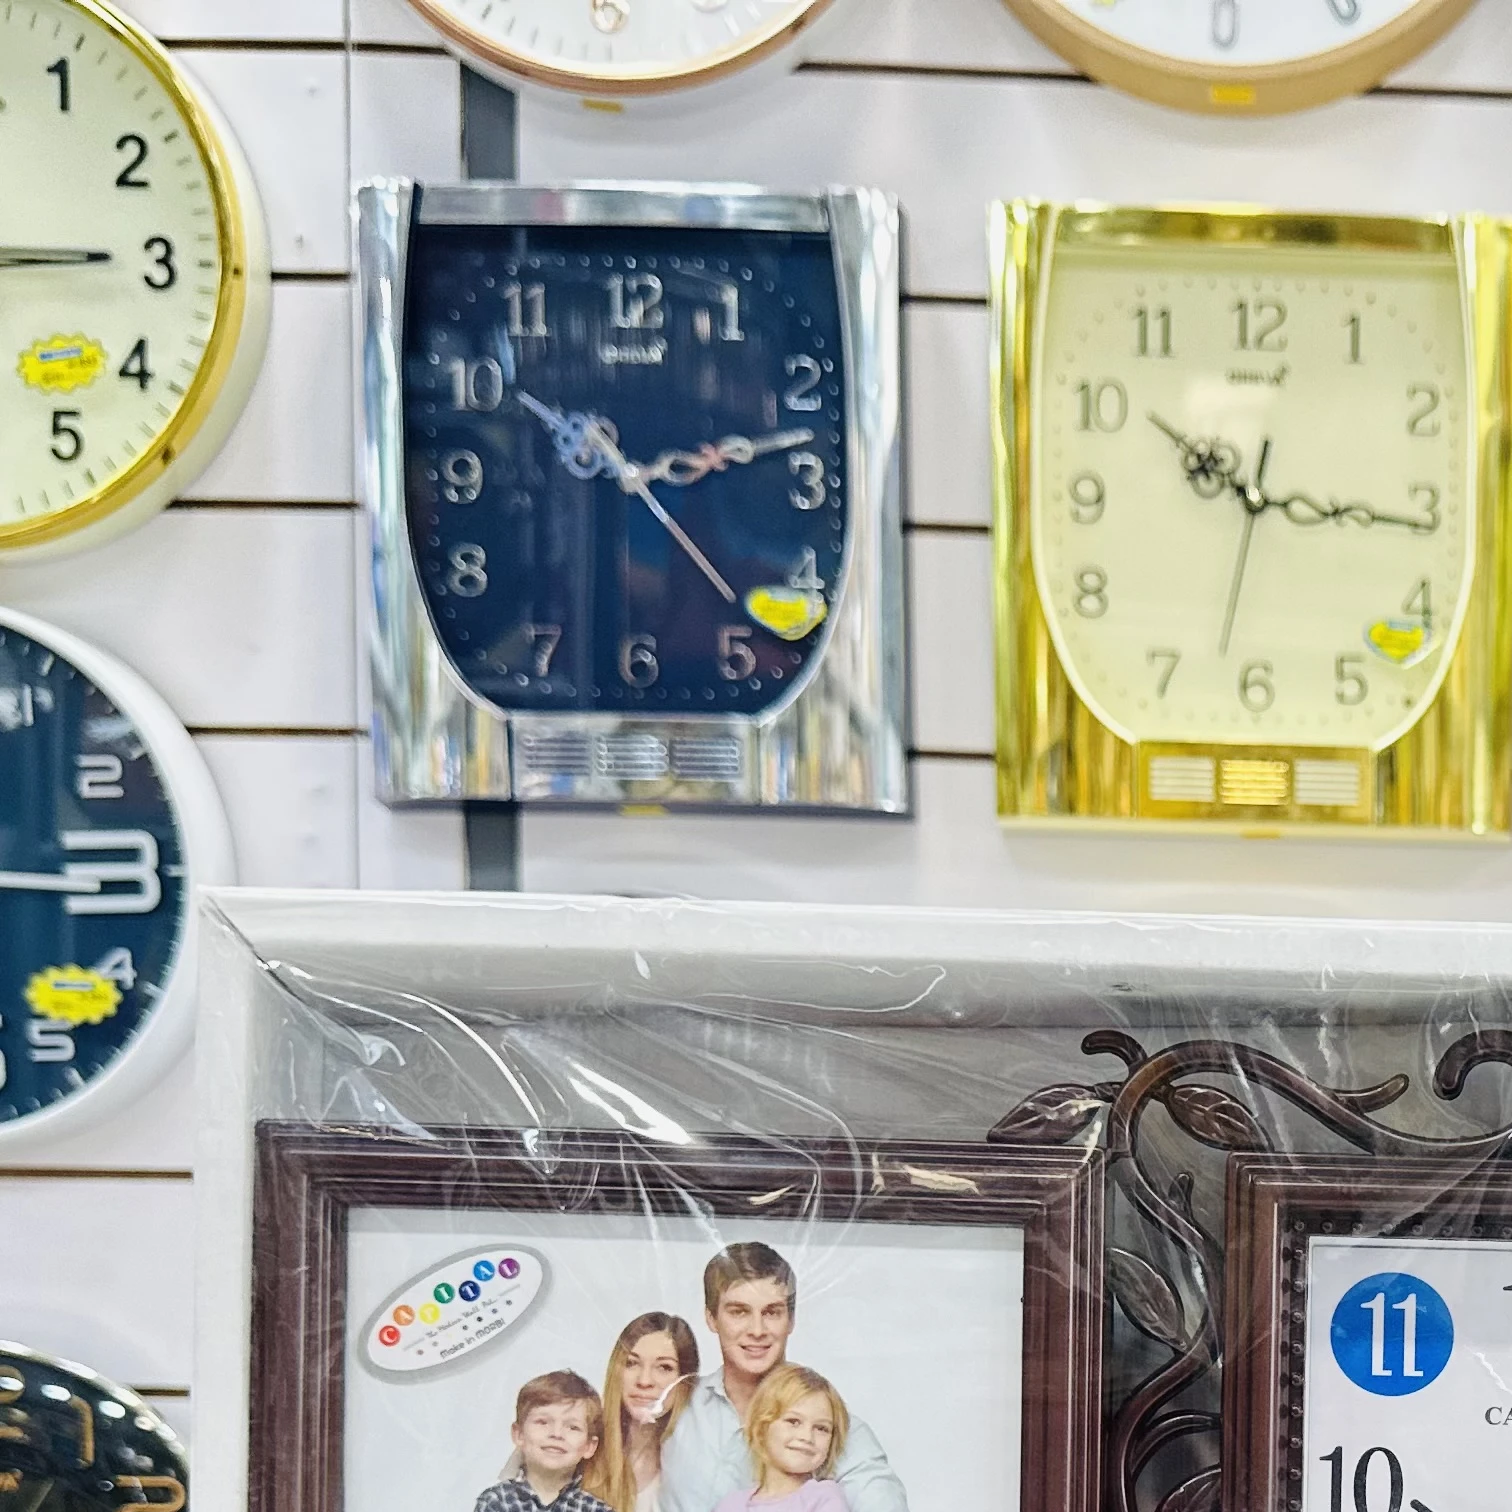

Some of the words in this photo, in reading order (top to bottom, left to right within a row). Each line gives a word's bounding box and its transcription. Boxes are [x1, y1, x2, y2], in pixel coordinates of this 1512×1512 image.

[46, 57, 70, 113] 1
[116, 134, 149, 188] 2
[143, 236, 176, 291] 3
[503, 283, 549, 336] 11
[607, 274, 664, 328] 12
[717, 284, 744, 340] 1
[1231, 300, 1288, 352] 12
[1135, 307, 1174, 356] 11
[1345, 314, 1363, 363] 1
[118, 338, 153, 390] 4
[448, 358, 503, 411] 10
[785, 353, 821, 411] 2
[1074, 379, 1128, 432] 10
[1407, 383, 1440, 436] 2
[50, 410, 83, 462] 5
[440, 449, 482, 503] 9
[789, 453, 825, 509] 3
[1070, 471, 1104, 524] 9
[1409, 483, 1441, 536] 3
[447, 543, 487, 597] 8
[787, 545, 825, 602] 4
[1074, 566, 1108, 618] 8
[1402, 577, 1438, 629] 4
[523, 625, 562, 676] 7
[620, 634, 658, 688] 6
[718, 626, 756, 680] 5
[1147, 650, 1182, 697] 7
[1239, 660, 1275, 712] 6
[1336, 654, 1368, 705] 5
[75, 753, 125, 799] 2
[61, 828, 161, 915] 3
[379, 1258, 521, 1346] CAPITAL
[1361, 1292, 1423, 1376] 11
